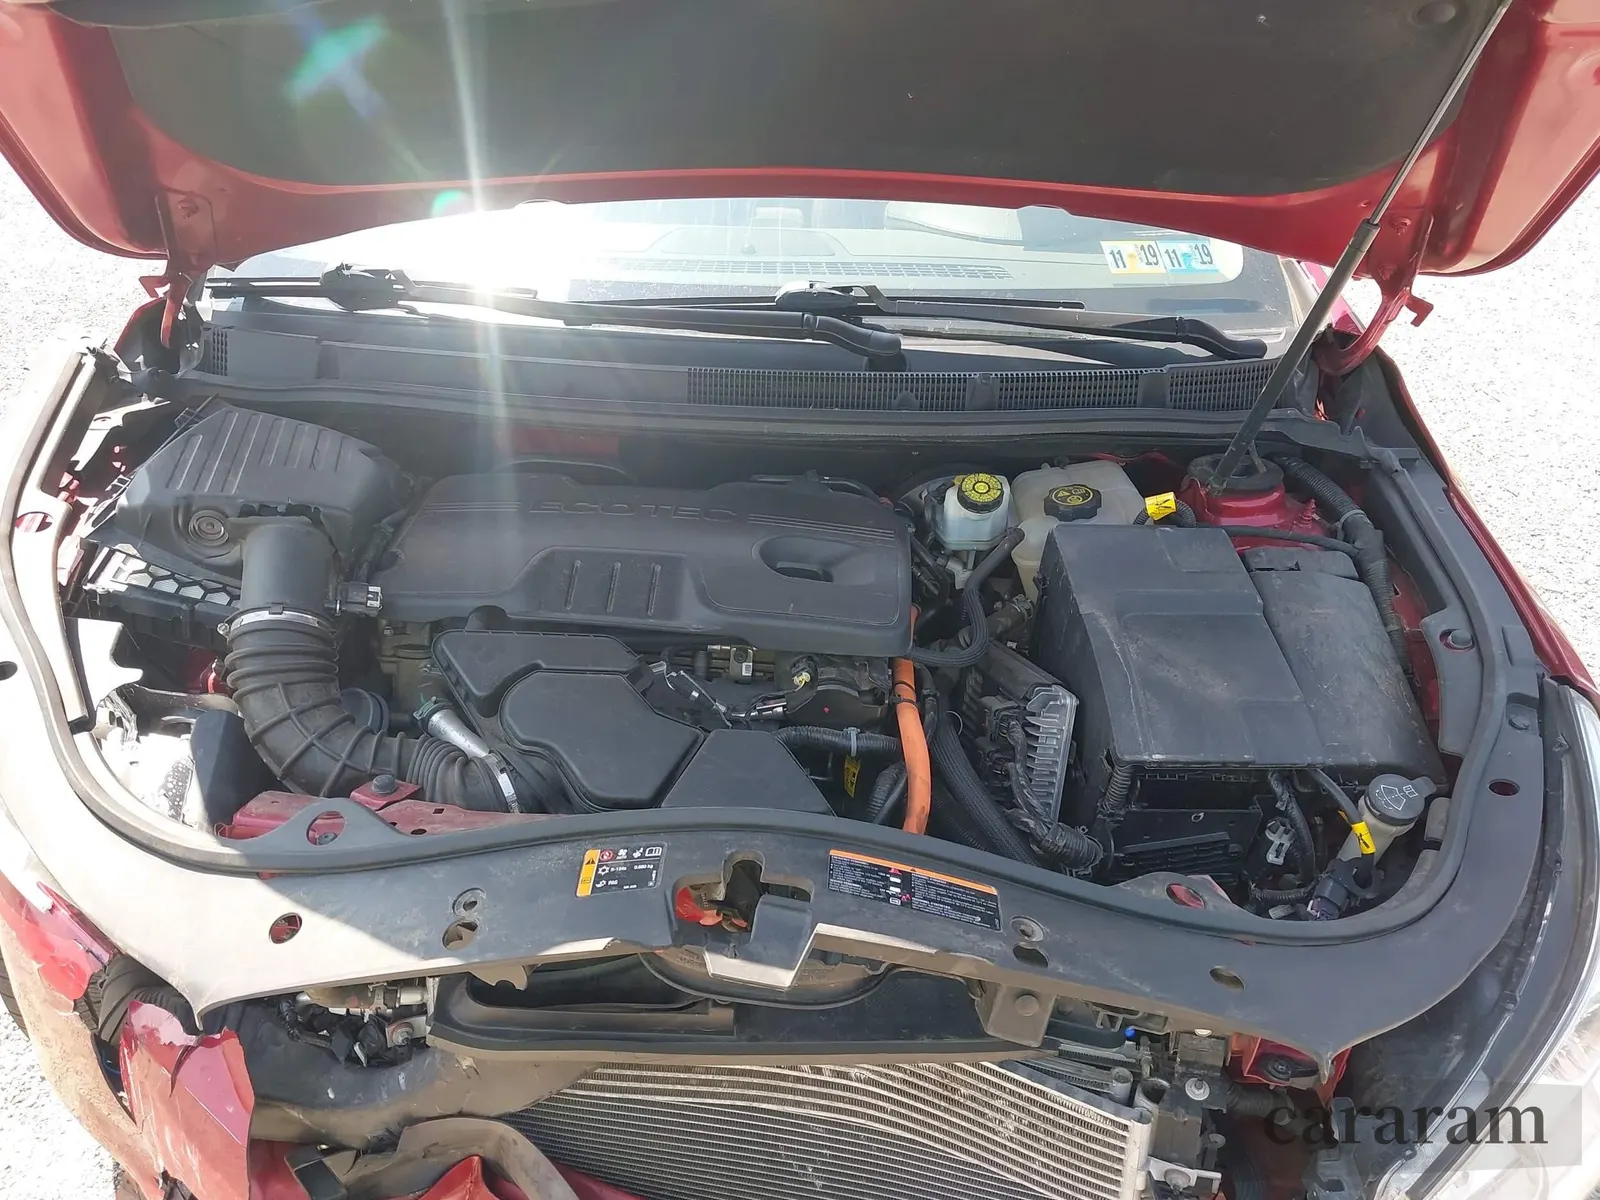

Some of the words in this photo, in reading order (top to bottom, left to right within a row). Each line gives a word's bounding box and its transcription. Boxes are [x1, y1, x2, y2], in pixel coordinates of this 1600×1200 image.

[1109, 249, 1127, 269] 11
[1140, 244, 1159, 266] 19
[1164, 248, 1182, 268] 11
[1195, 243, 1213, 265] 19
[529, 500, 738, 523] ECOTEC
